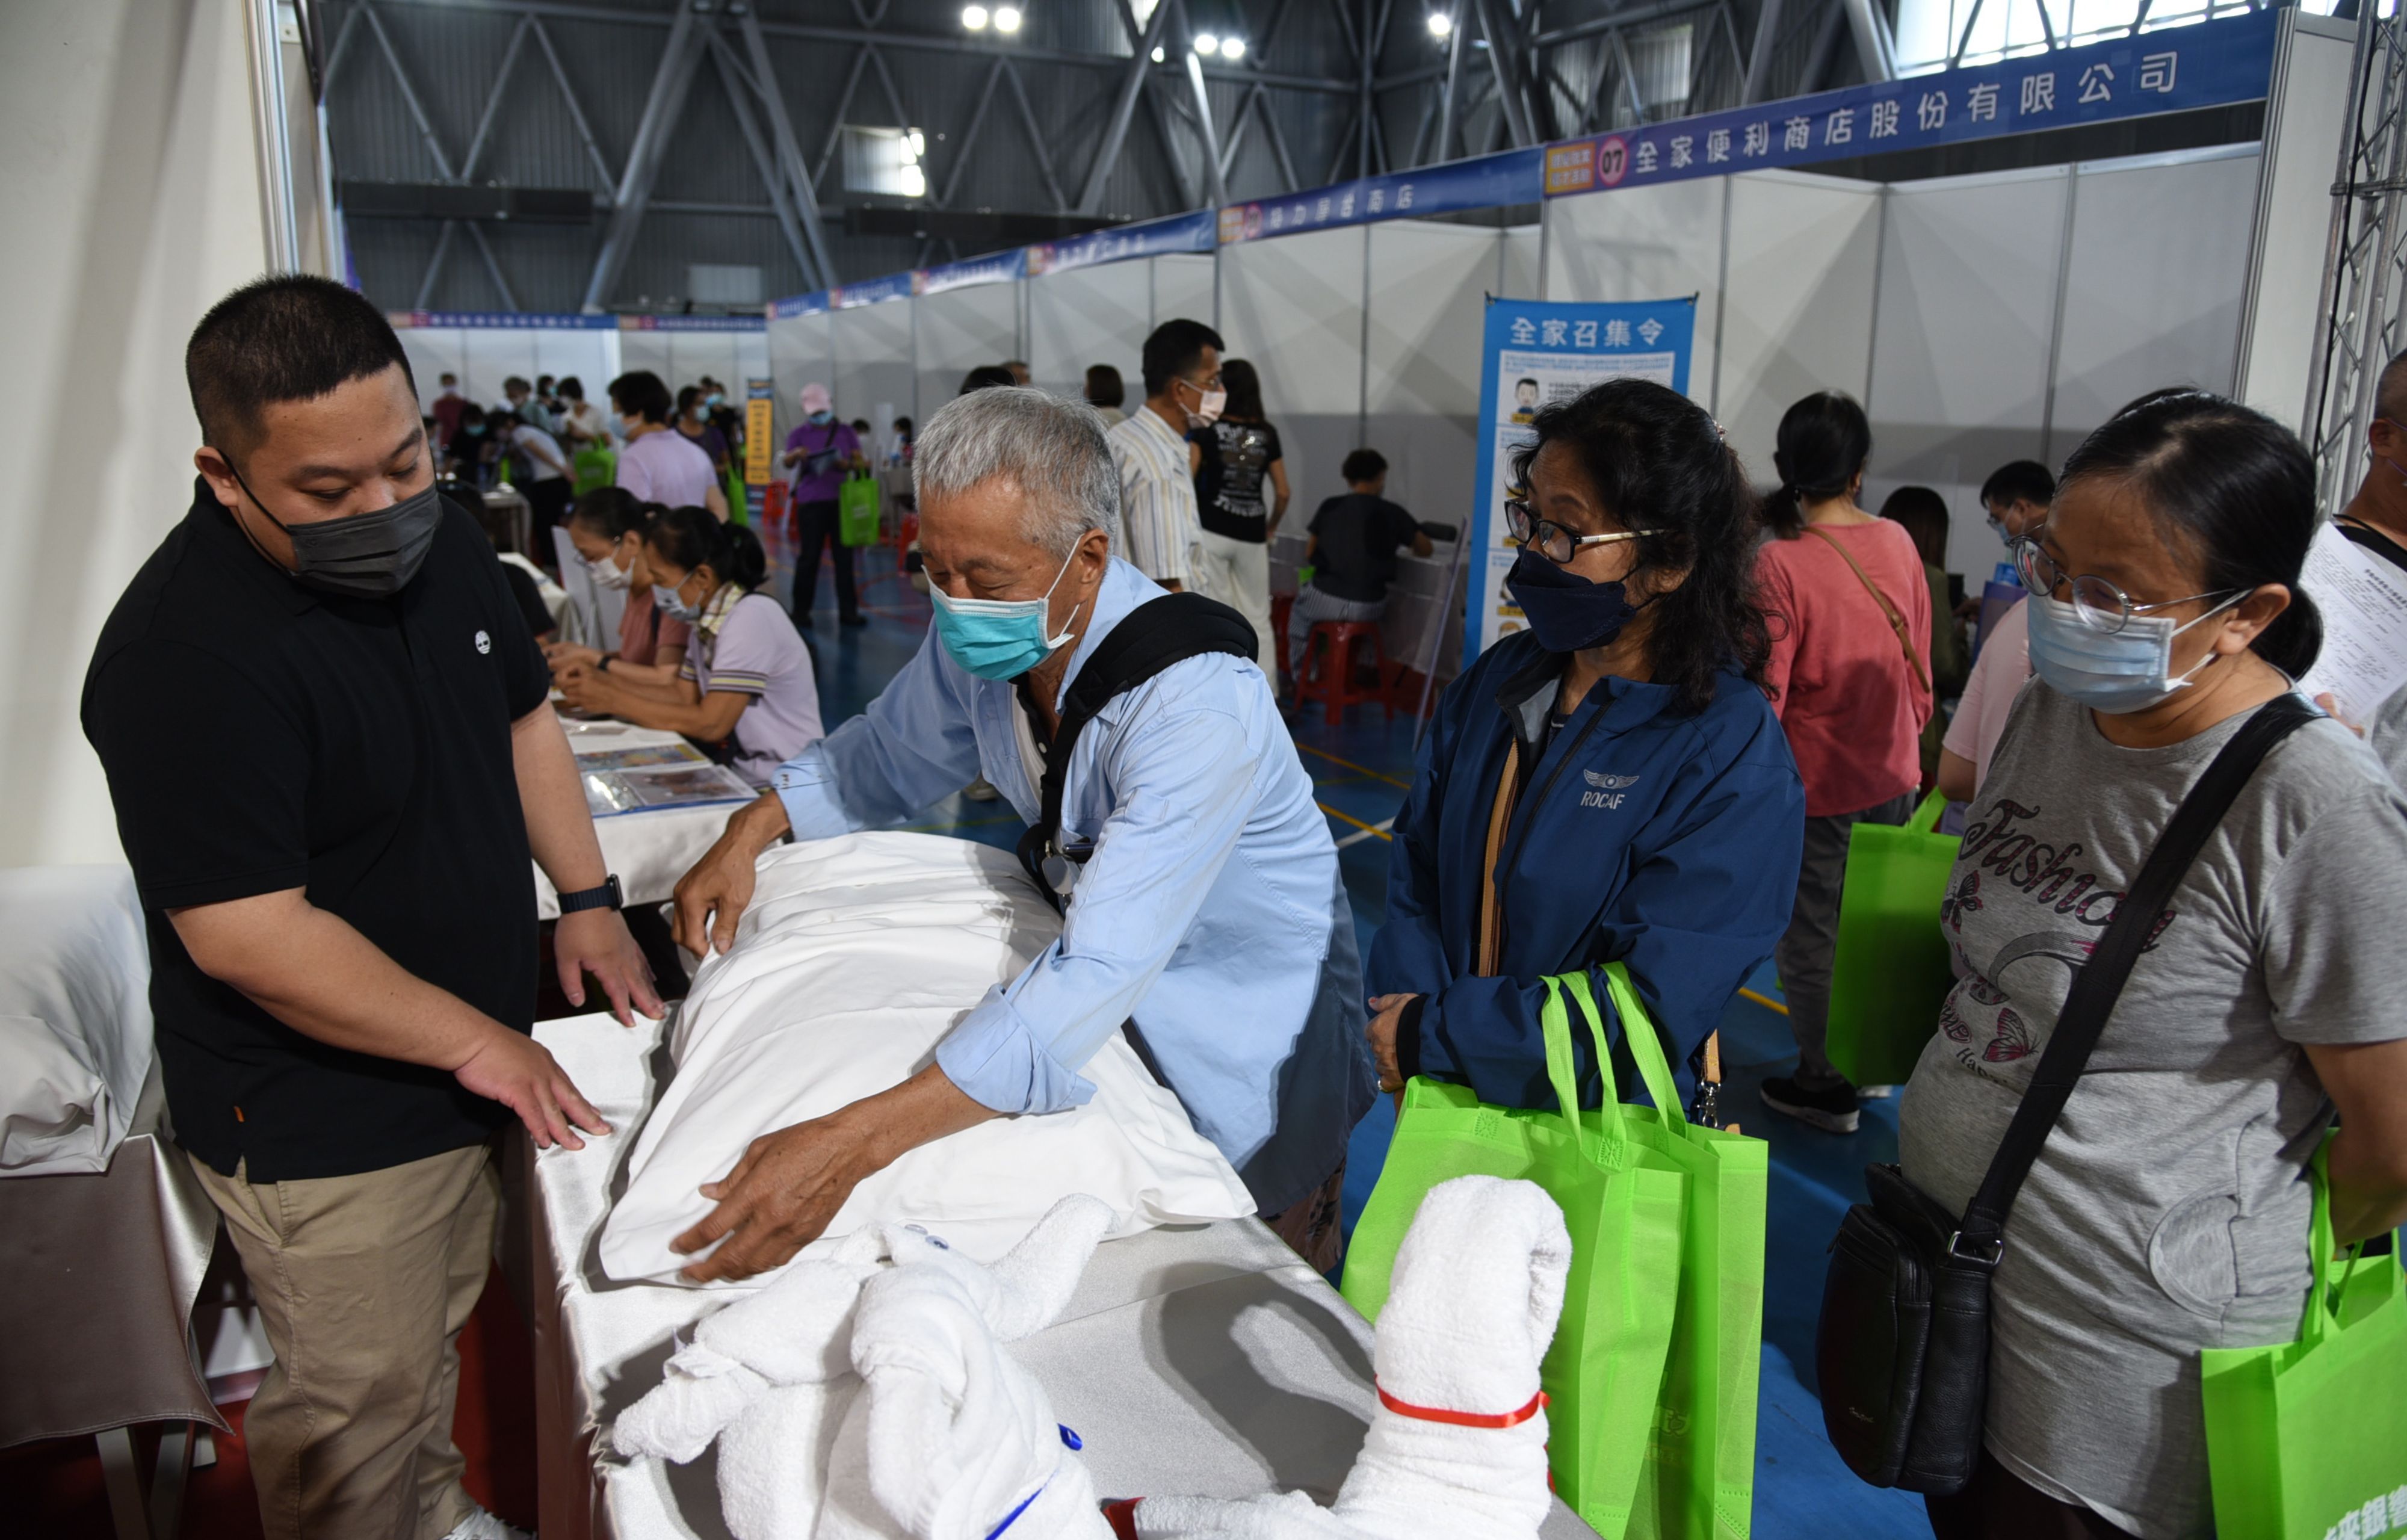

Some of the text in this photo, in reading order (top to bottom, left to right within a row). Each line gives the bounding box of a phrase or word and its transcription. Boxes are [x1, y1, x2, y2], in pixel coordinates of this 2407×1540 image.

[1602, 149, 1623, 175] 07
[1636, 51, 2180, 175] 全家便利商店股份有限公司
[1510, 317, 1665, 348] 全家召集令
[1580, 791, 1625, 810] ROCAF
